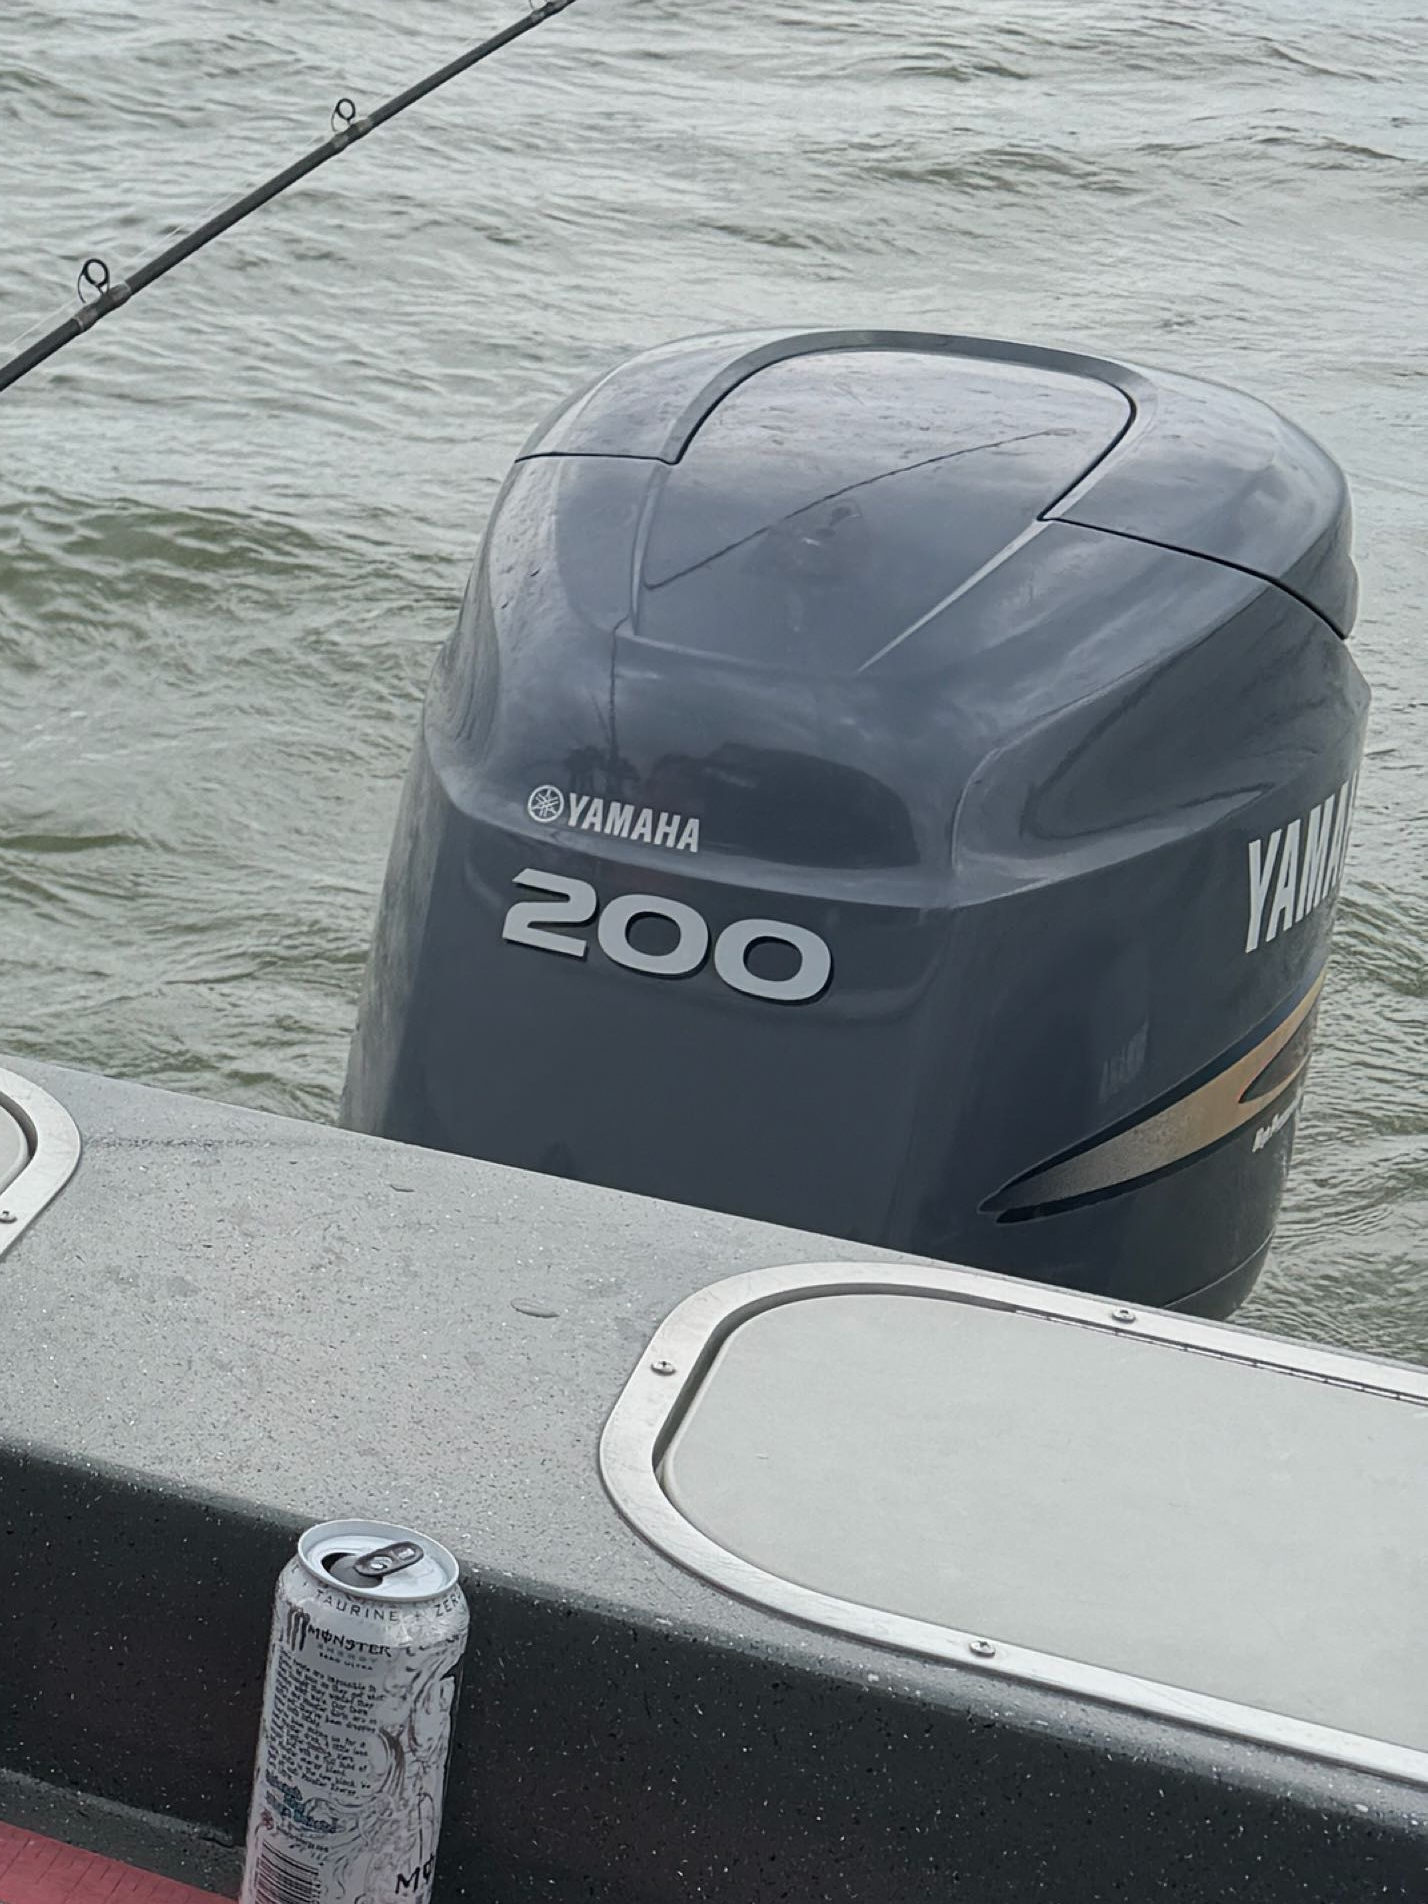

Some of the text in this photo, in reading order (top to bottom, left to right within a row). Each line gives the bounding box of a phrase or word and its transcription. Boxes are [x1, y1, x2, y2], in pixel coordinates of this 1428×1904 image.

[567, 792, 701, 852] YAMAHA
[502, 868, 833, 1005] 200
[315, 1590, 400, 1622] TAURINE
[307, 1623, 393, 1658] MONSTER
